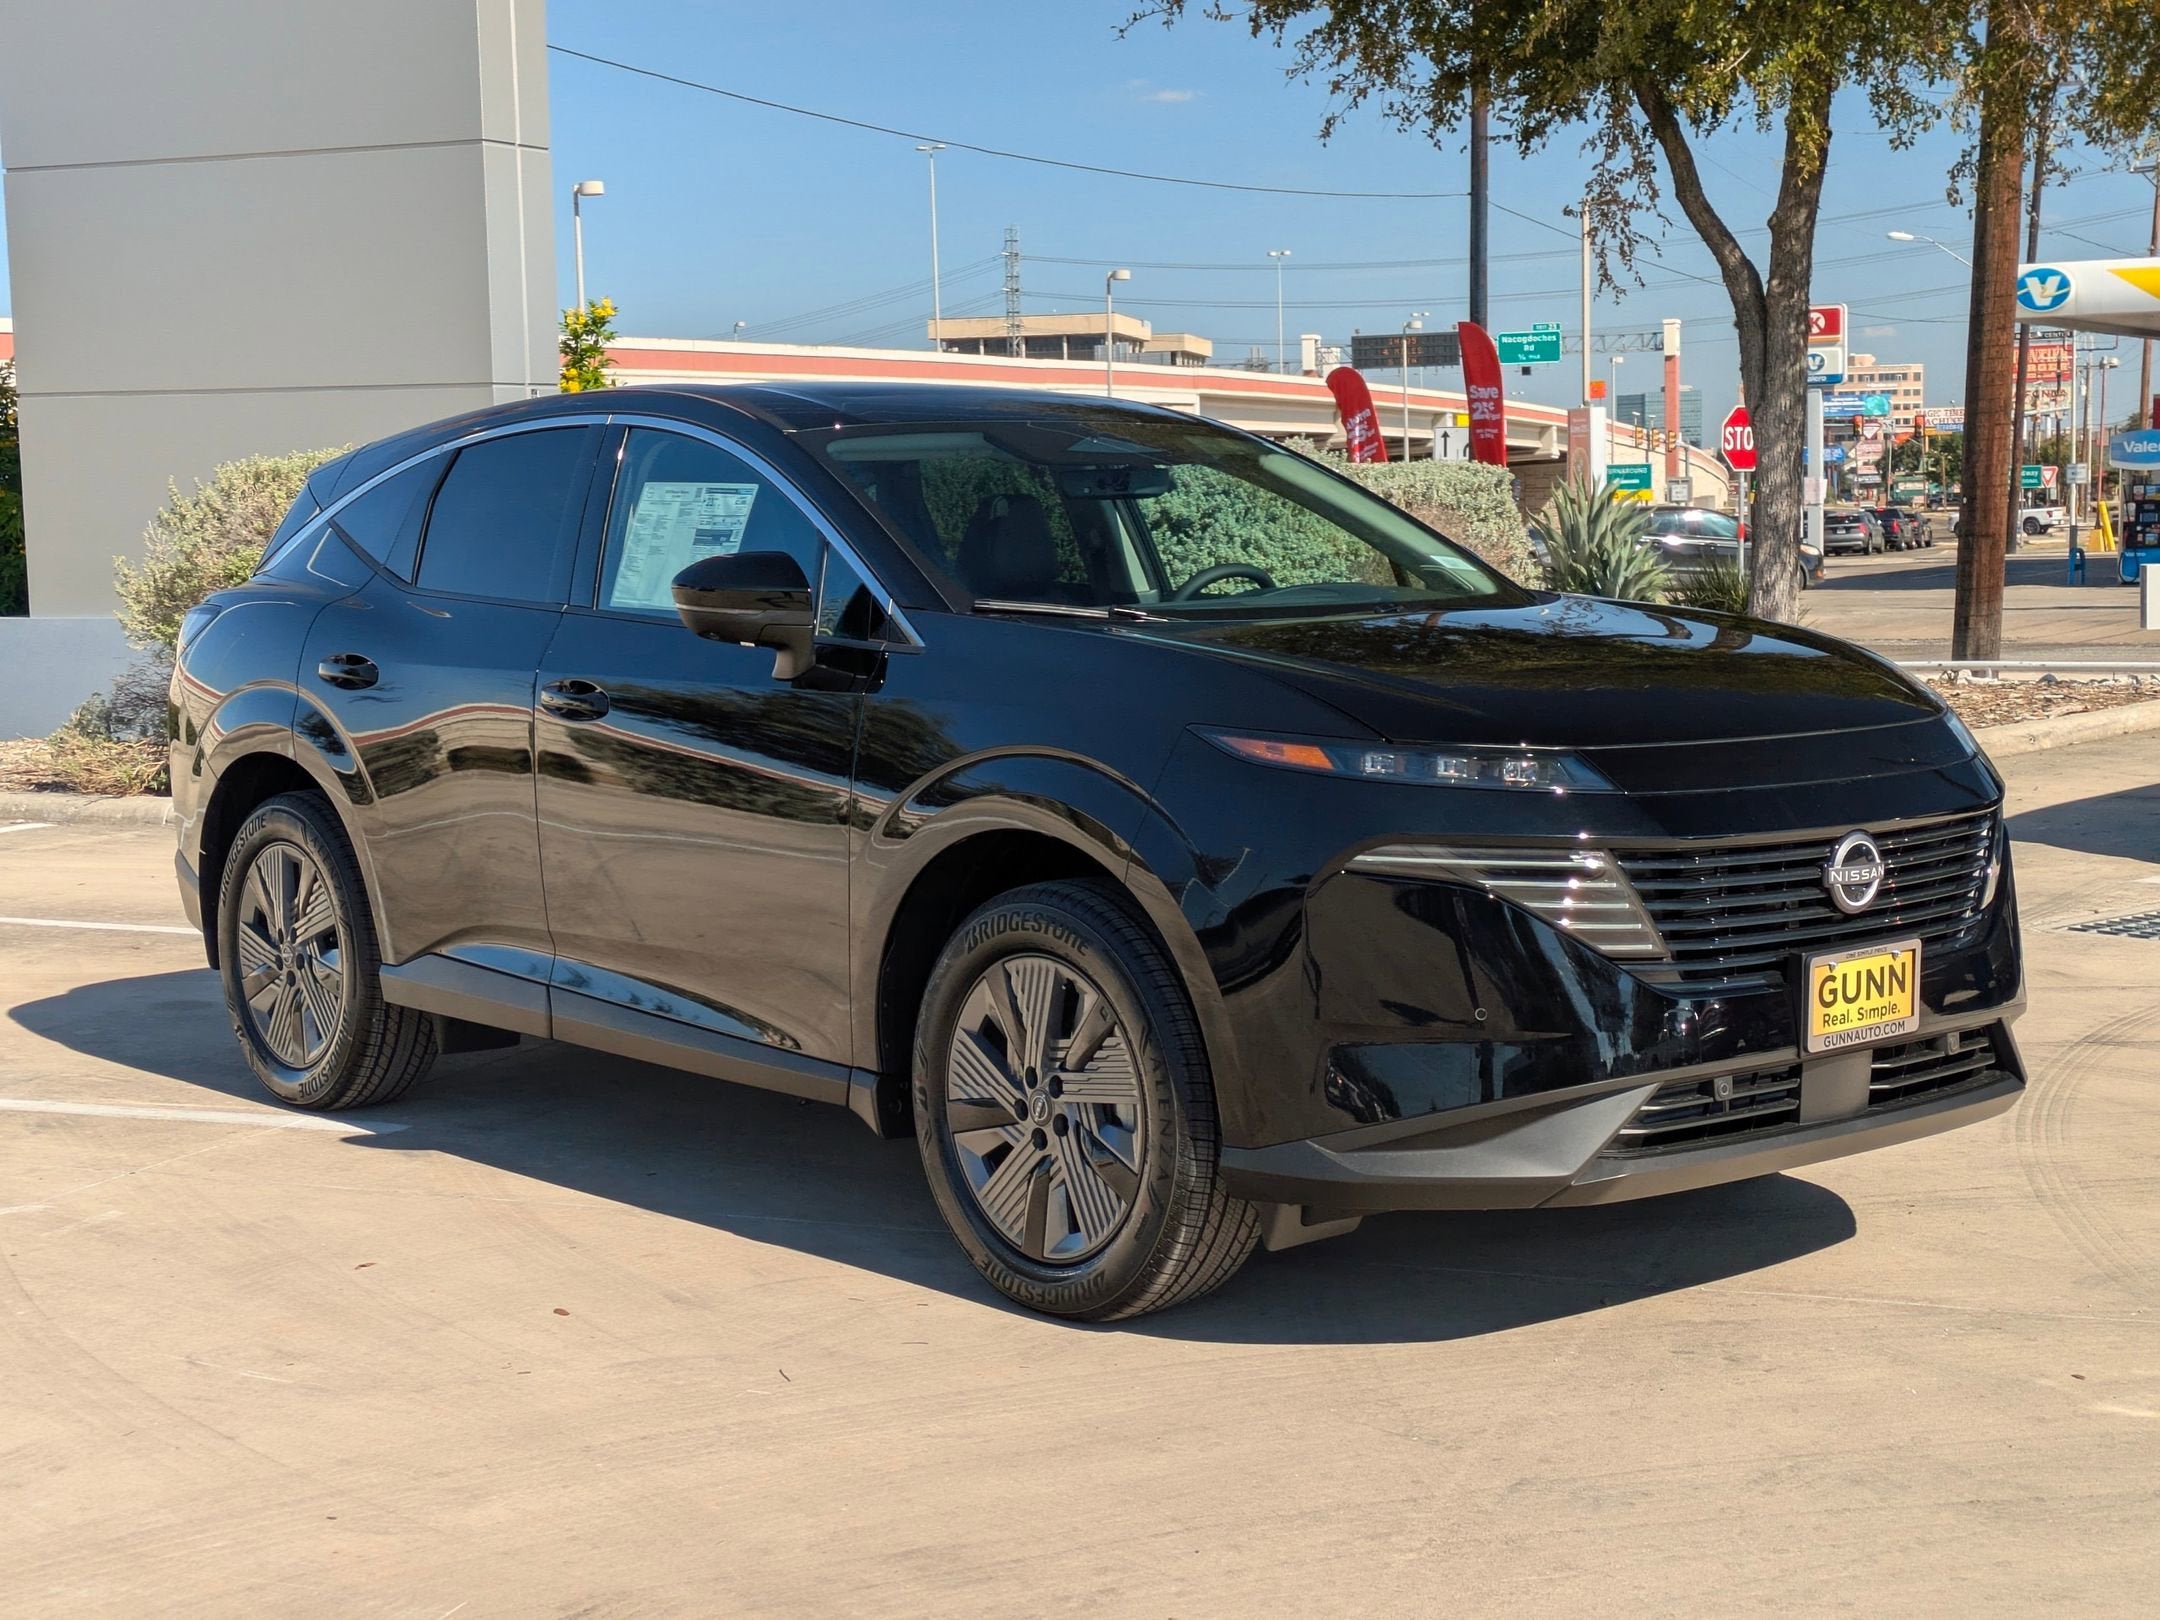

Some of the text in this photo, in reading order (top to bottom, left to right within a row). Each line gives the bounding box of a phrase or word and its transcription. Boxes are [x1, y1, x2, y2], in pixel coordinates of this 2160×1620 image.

[1501, 334, 1557, 344] Nacogdoches
[1807, 375, 1827, 383] alero
[1470, 385, 1499, 399] Save
[1922, 417, 1964, 426] ACHINE
[1724, 426, 1754, 451] STO
[1830, 863, 1885, 882] NISSAN
[963, 910, 1089, 956] BRIDGESTONE
[1818, 961, 1906, 1009] GUNN
[1823, 1010, 1853, 1029] Real.
[1823, 1020, 1906, 1048] GUNNAUTO.COM
[1149, 1055, 1175, 1181] ALENZA
